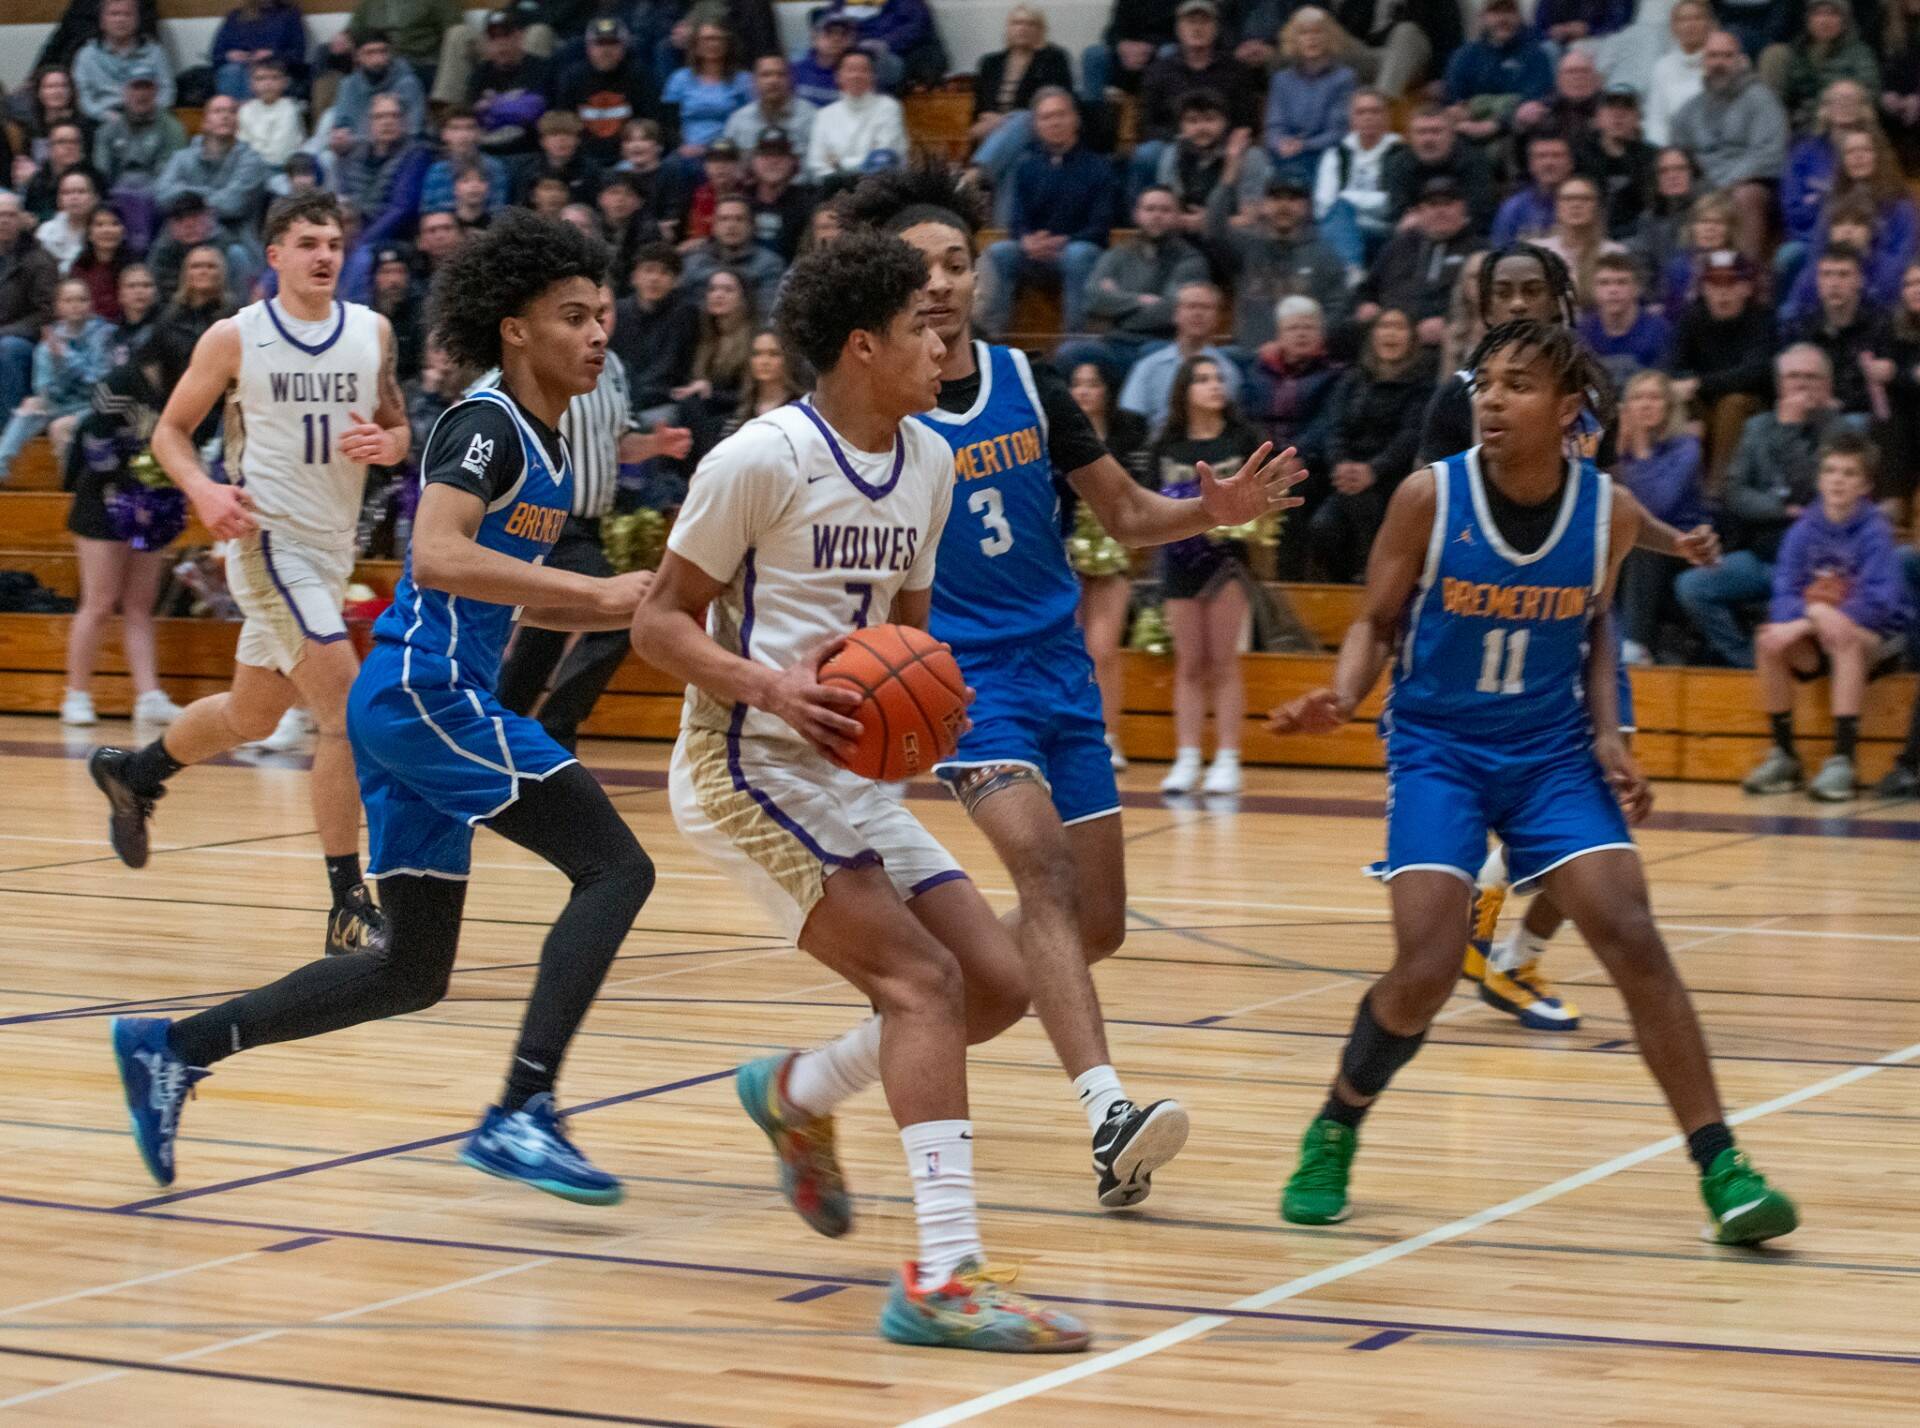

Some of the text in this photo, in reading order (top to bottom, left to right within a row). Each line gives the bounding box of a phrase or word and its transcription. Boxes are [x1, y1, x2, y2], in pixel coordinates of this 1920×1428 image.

[270, 372, 358, 403] WOLVES
[302, 413, 331, 465] 11
[812, 524, 918, 571] WOLVES
[967, 486, 1015, 559] 3
[1475, 628, 1531, 695] 11
